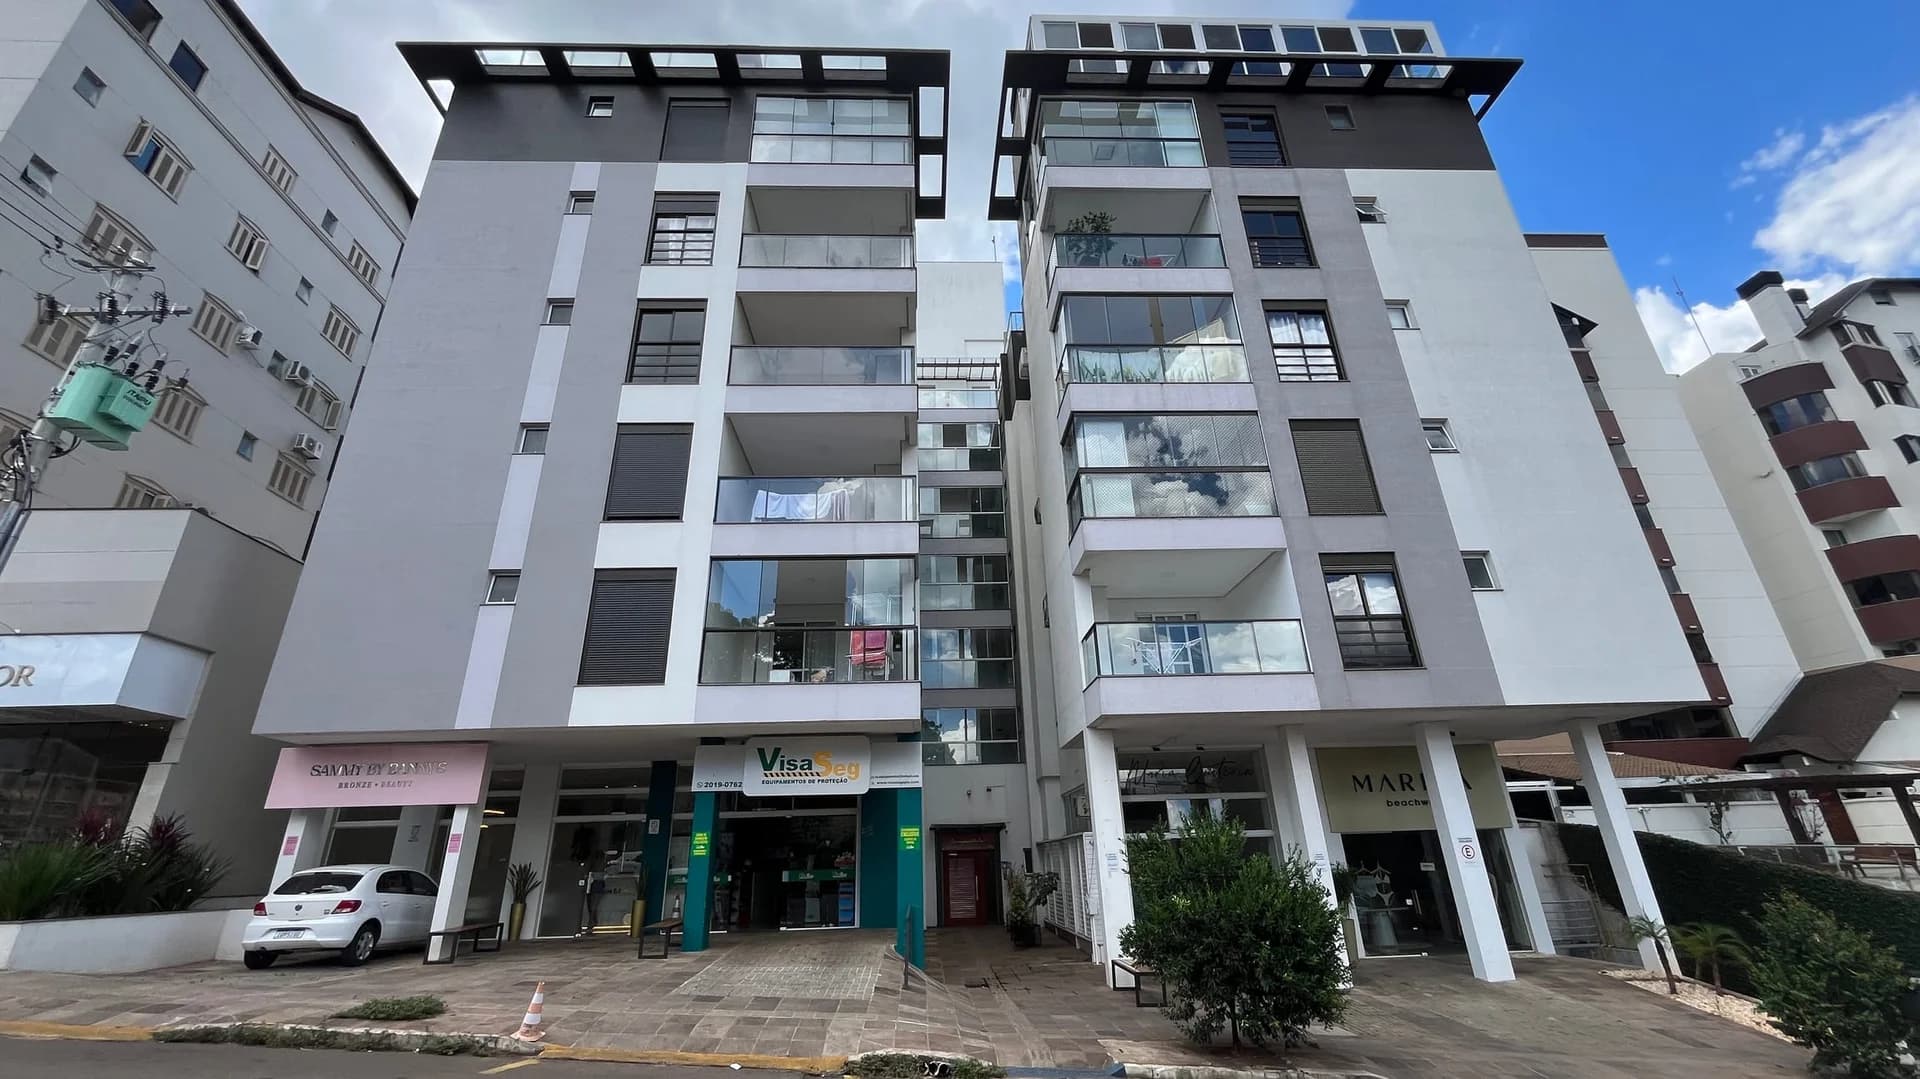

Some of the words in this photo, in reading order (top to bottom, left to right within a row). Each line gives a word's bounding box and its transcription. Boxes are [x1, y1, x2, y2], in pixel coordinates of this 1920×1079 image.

[757, 747, 861, 780] VisaSeg
[366, 762, 386, 776] BY
[337, 781, 373, 789] BRONZE
[817, 777, 848, 785] PROTEÇÃO
[1386, 799, 1430, 808] beachw
